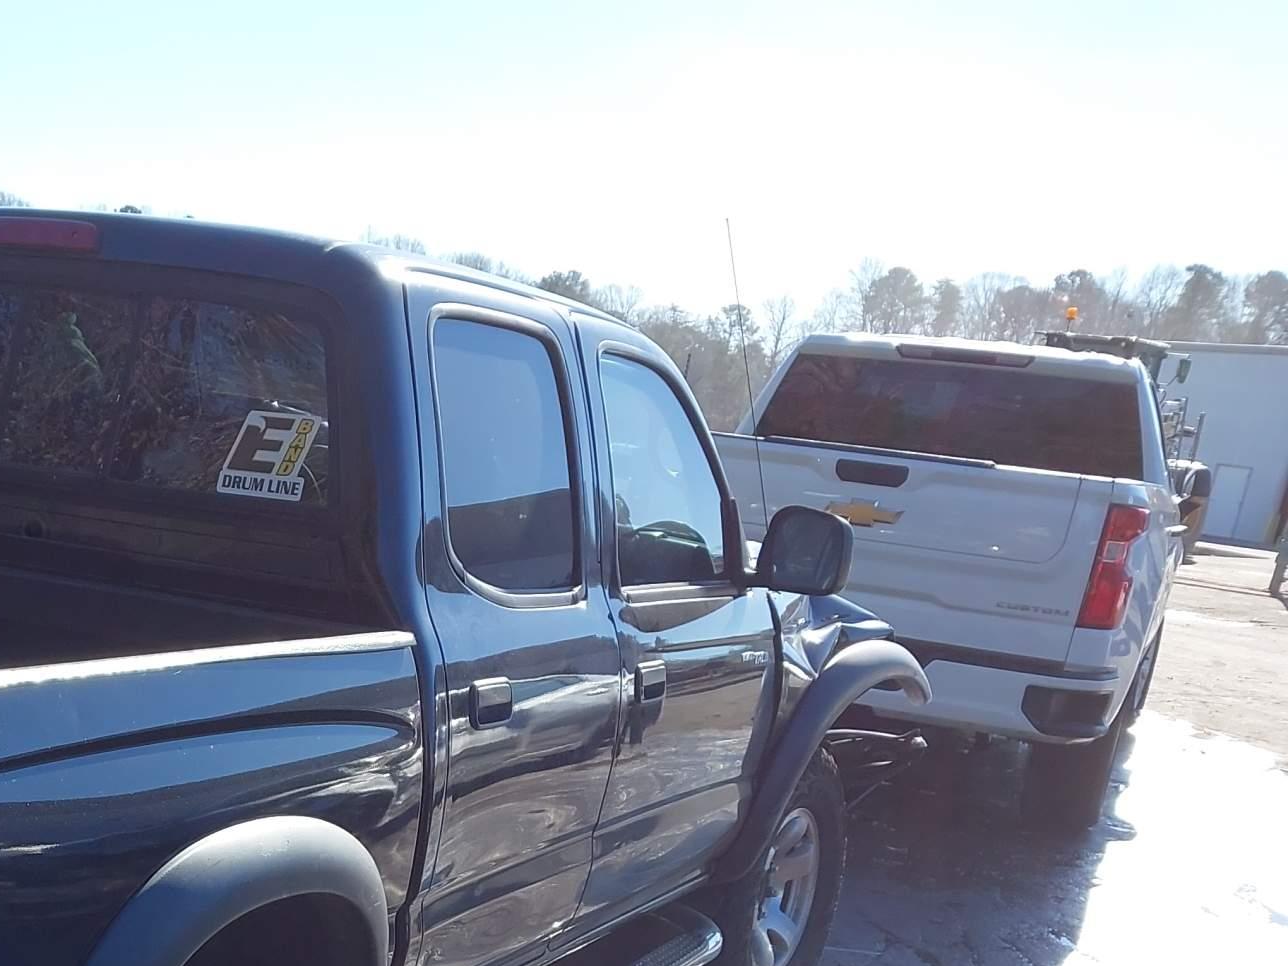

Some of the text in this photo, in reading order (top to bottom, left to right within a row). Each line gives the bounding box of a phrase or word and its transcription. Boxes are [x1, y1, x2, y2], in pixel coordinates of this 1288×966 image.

[228, 416, 296, 473] E
[276, 419, 315, 476] BAND
[222, 474, 301, 496] DRUM LINE
[996, 601, 1070, 616] CUSTOM
